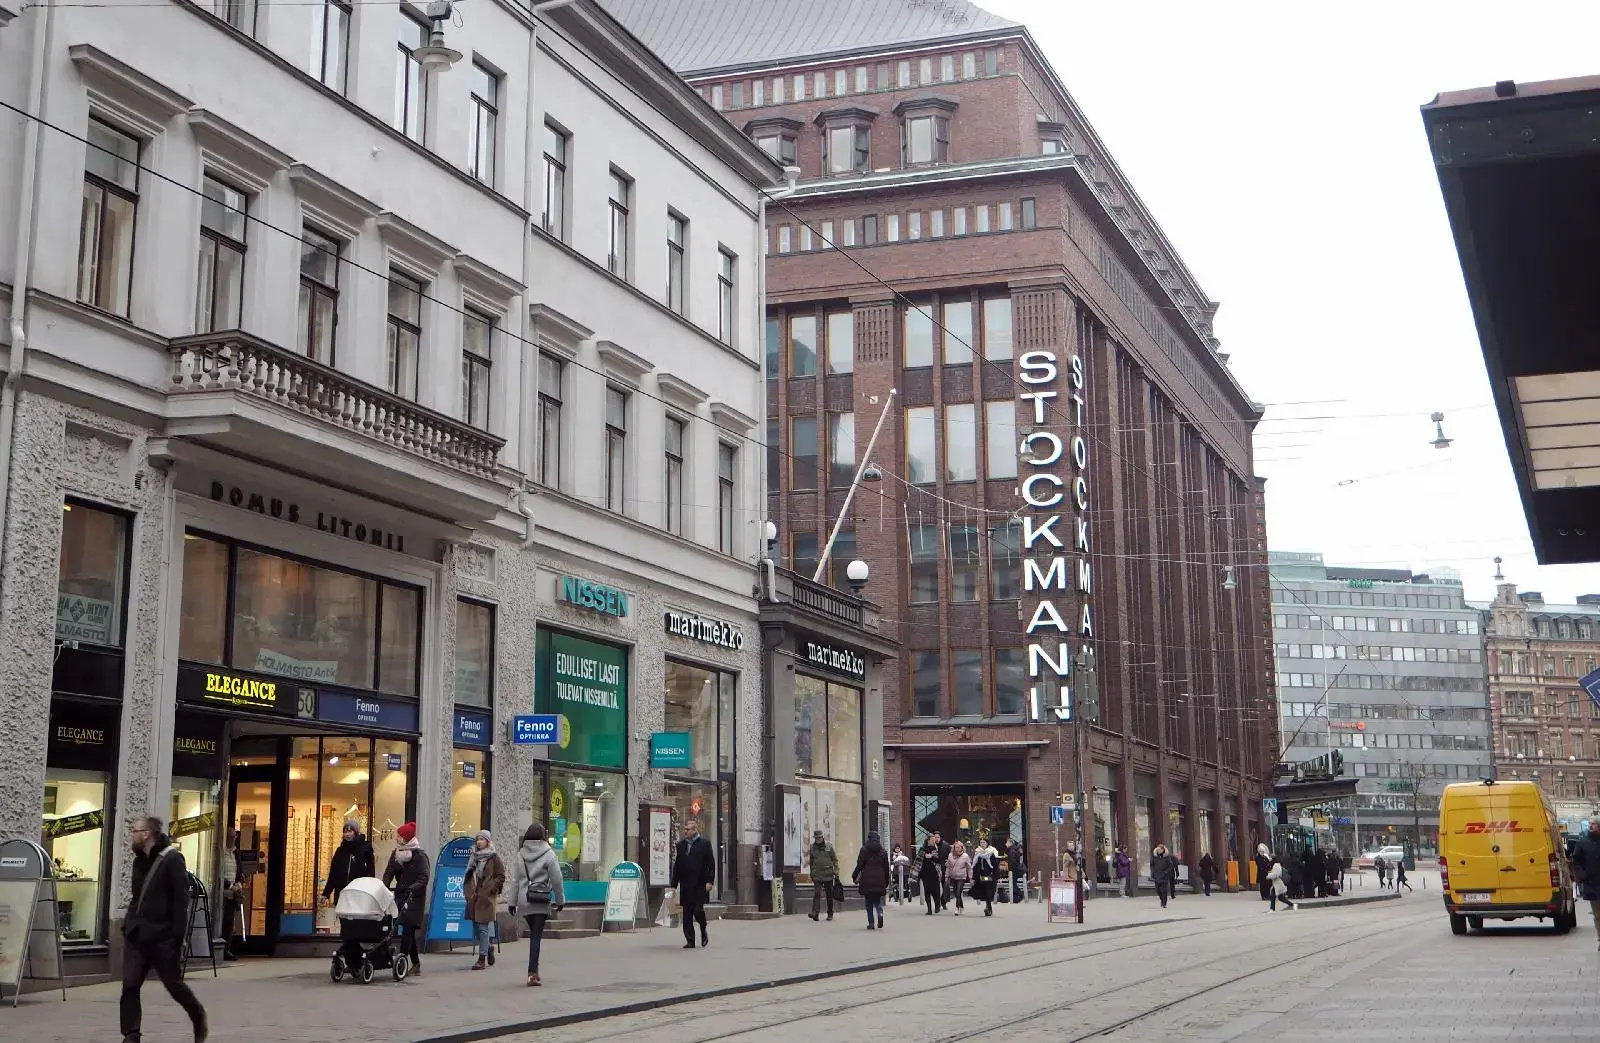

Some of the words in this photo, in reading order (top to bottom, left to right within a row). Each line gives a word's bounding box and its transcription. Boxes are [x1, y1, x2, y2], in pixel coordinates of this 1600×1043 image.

[211, 480, 300, 522] DOMUS
[1019, 350, 1071, 720] STOCKMANN
[562, 575, 629, 618] NISSEN
[668, 611, 744, 650] marimekko
[256, 652, 313, 678] HOLMASTO
[556, 652, 598, 681] EDULLISET
[598, 661, 620, 685] LASIT
[807, 642, 865, 675] marimekko
[206, 673, 276, 701] ELEGANCE
[556, 681, 584, 702] TULEVAT
[297, 691, 314, 714] 50
[356, 698, 380, 713] Fenno
[57, 726, 104, 742] ELEGANCE
[460, 716, 481, 731] Fenno
[517, 720, 554, 732] Fenno
[176, 738, 216, 751] ELEGANCE
[655, 747, 685, 755] NISSEN
[1465, 820, 1522, 834] DHL
